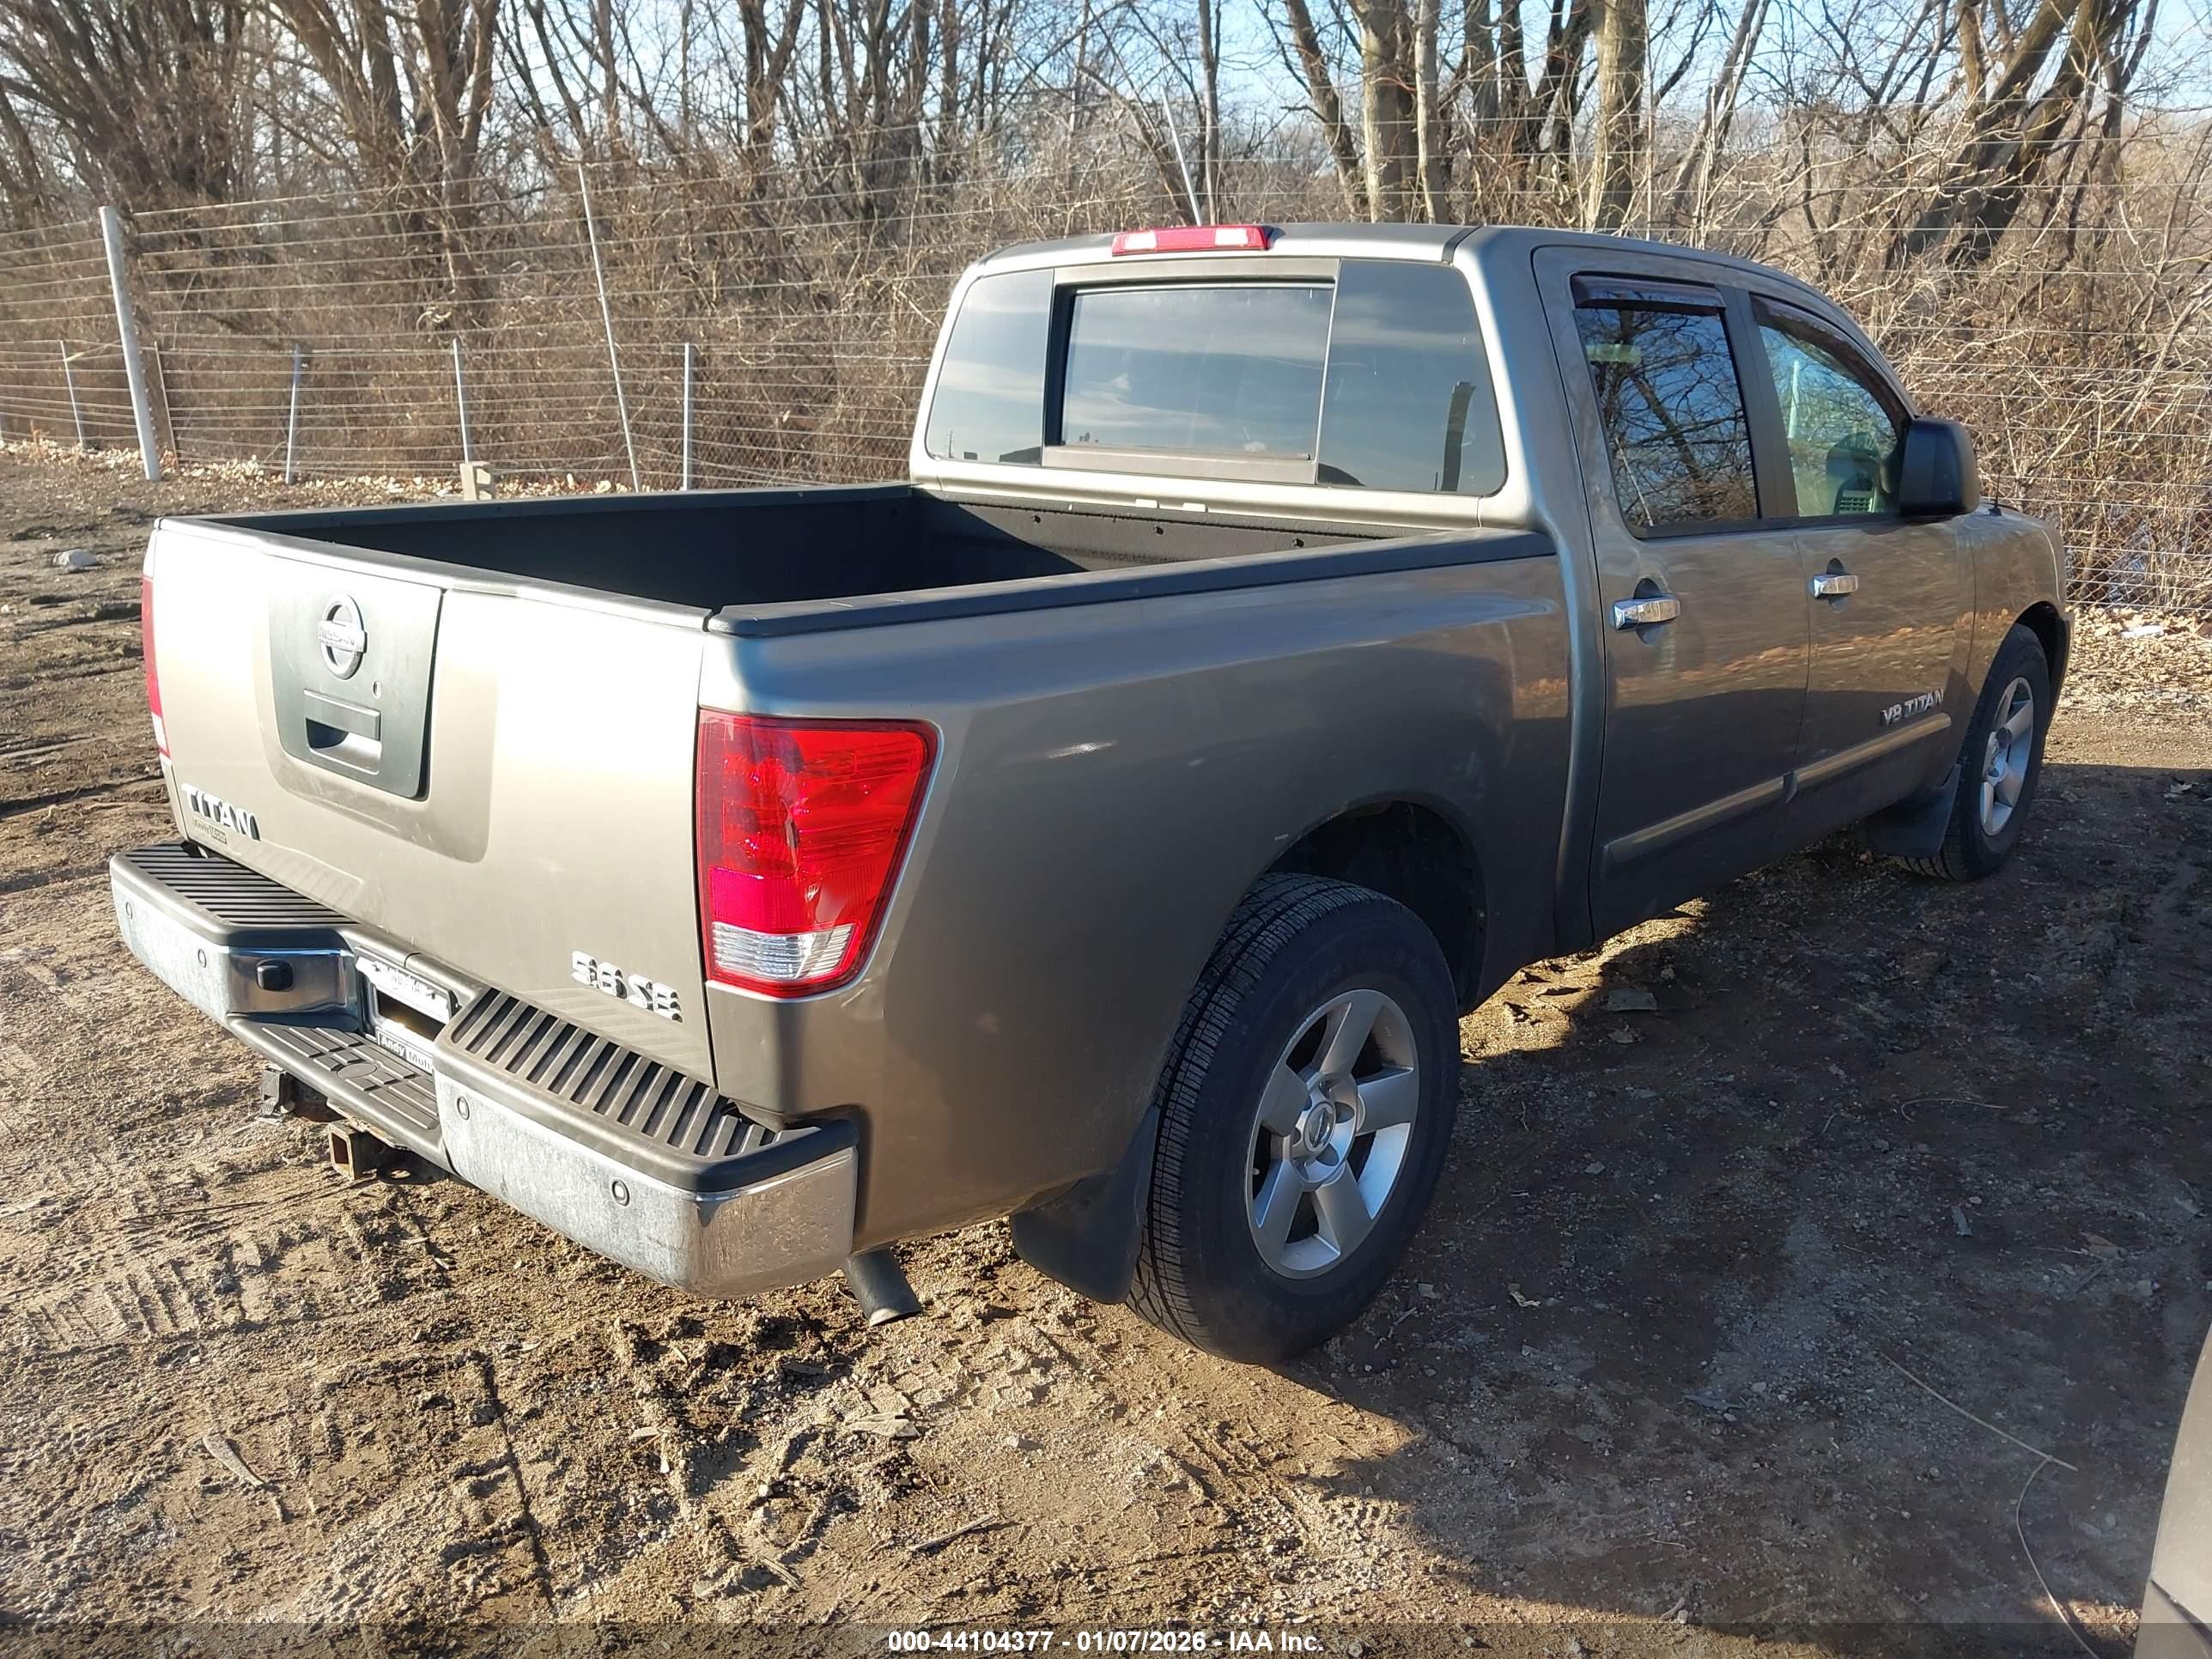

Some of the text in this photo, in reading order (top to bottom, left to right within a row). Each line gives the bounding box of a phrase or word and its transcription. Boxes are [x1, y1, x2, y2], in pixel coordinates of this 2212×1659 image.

[1881, 688, 1945, 726] V8 TITAN
[180, 782, 261, 842] TITAN
[627, 974, 684, 1023] SE
[381, 1036, 431, 1070] Andy Moh
